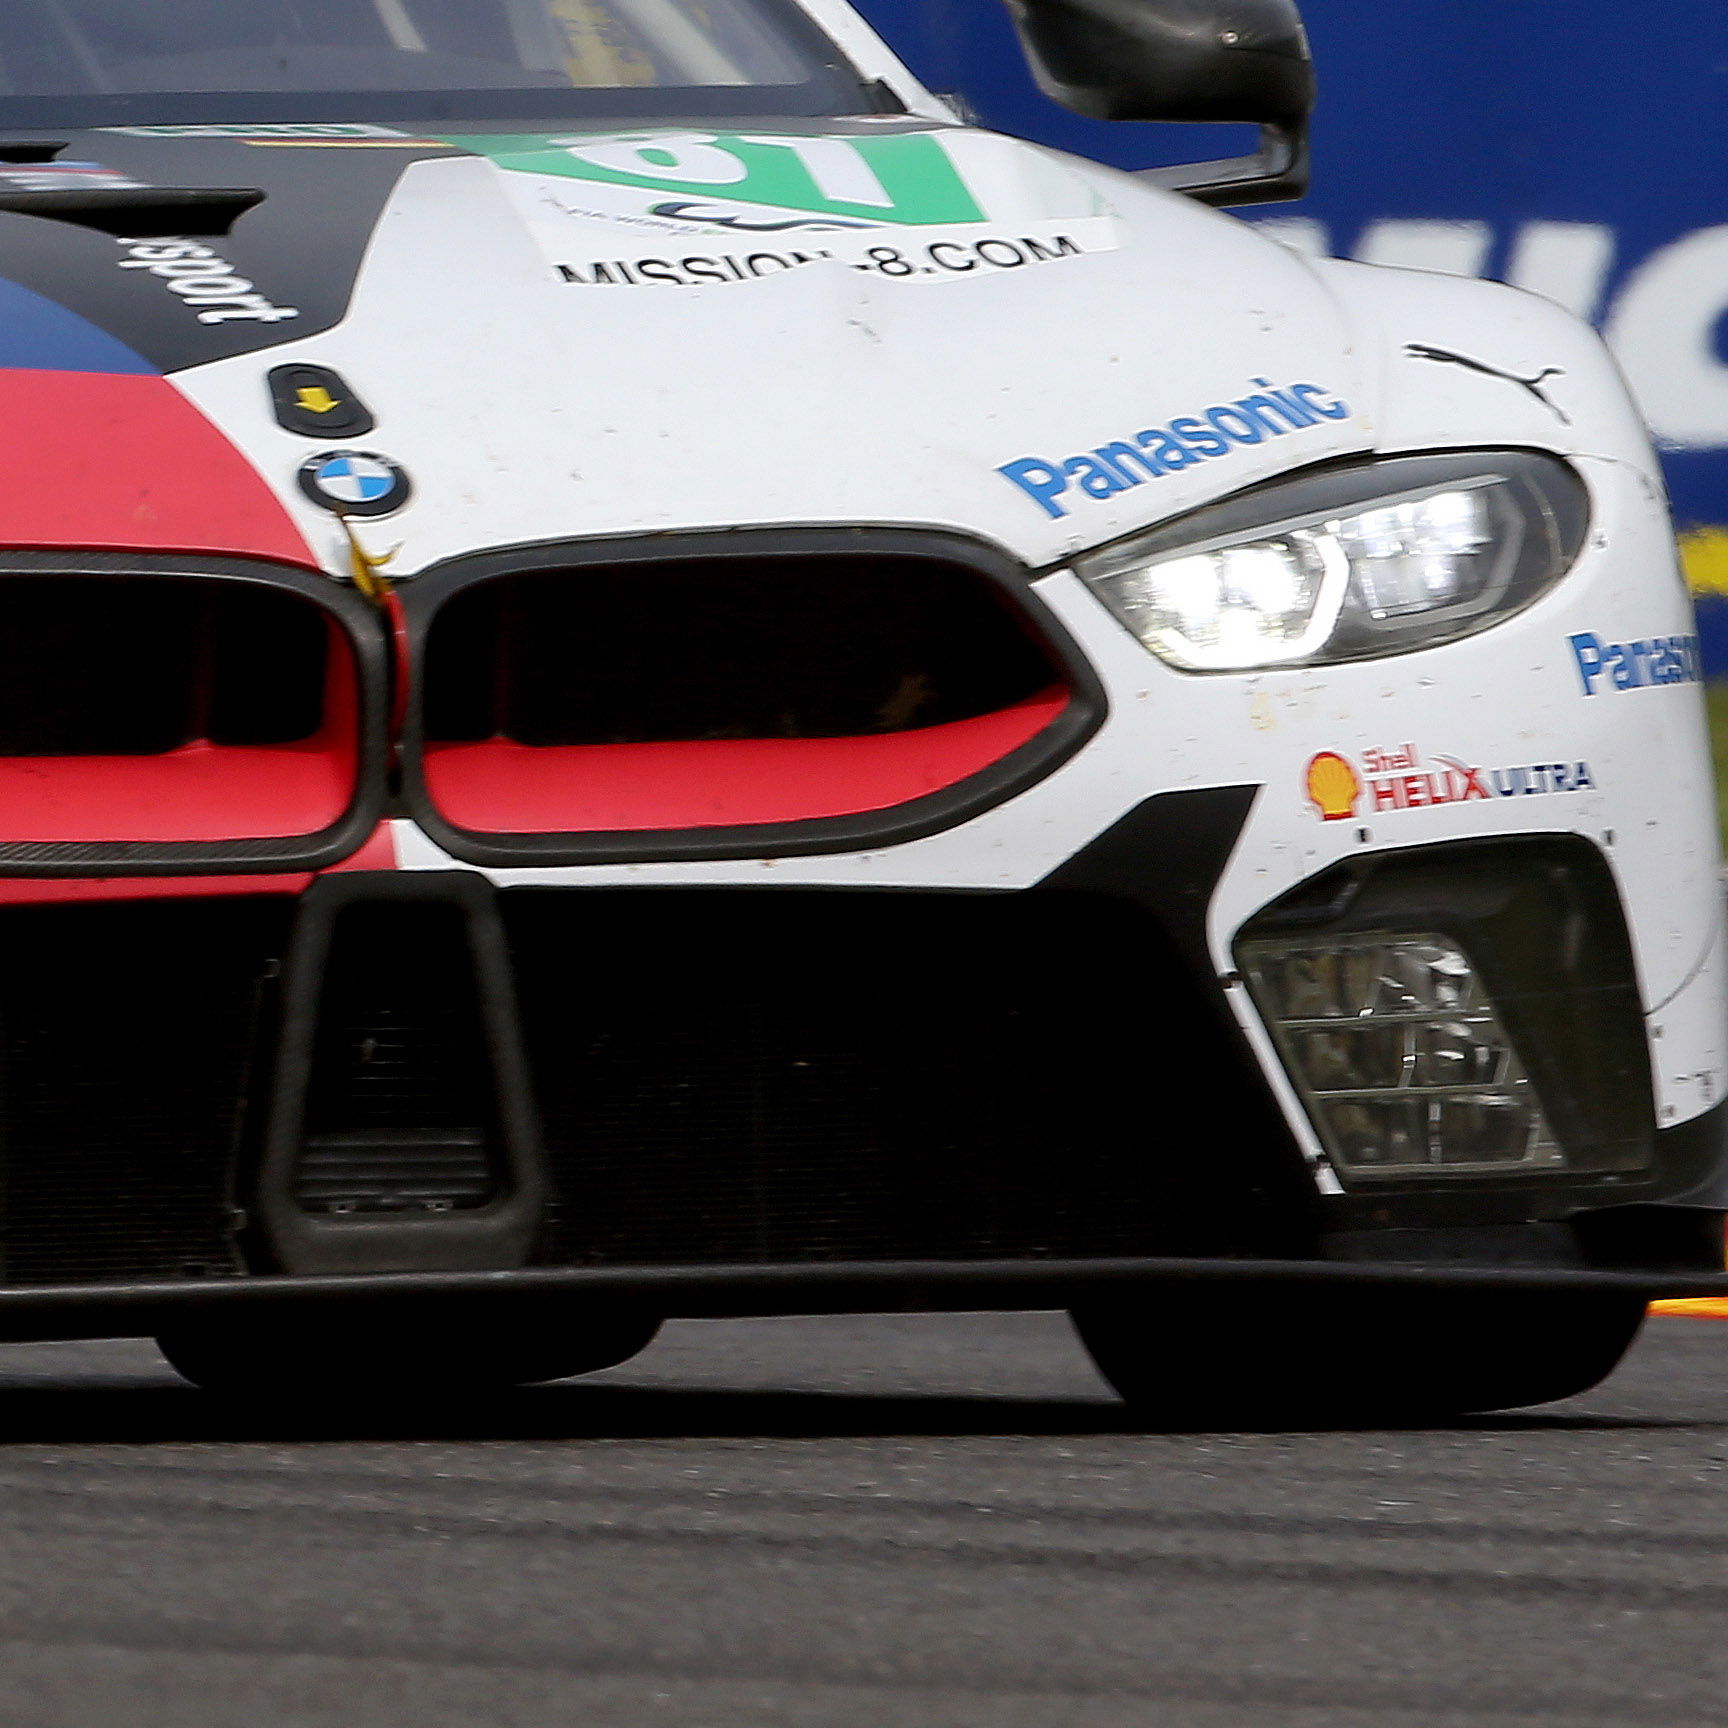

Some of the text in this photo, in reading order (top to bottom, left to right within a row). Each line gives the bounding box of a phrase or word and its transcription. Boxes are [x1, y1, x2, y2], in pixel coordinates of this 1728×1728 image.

[998, 376, 1349, 520] Panasonic
[1373, 760, 1596, 811] HELIX ULTRA
